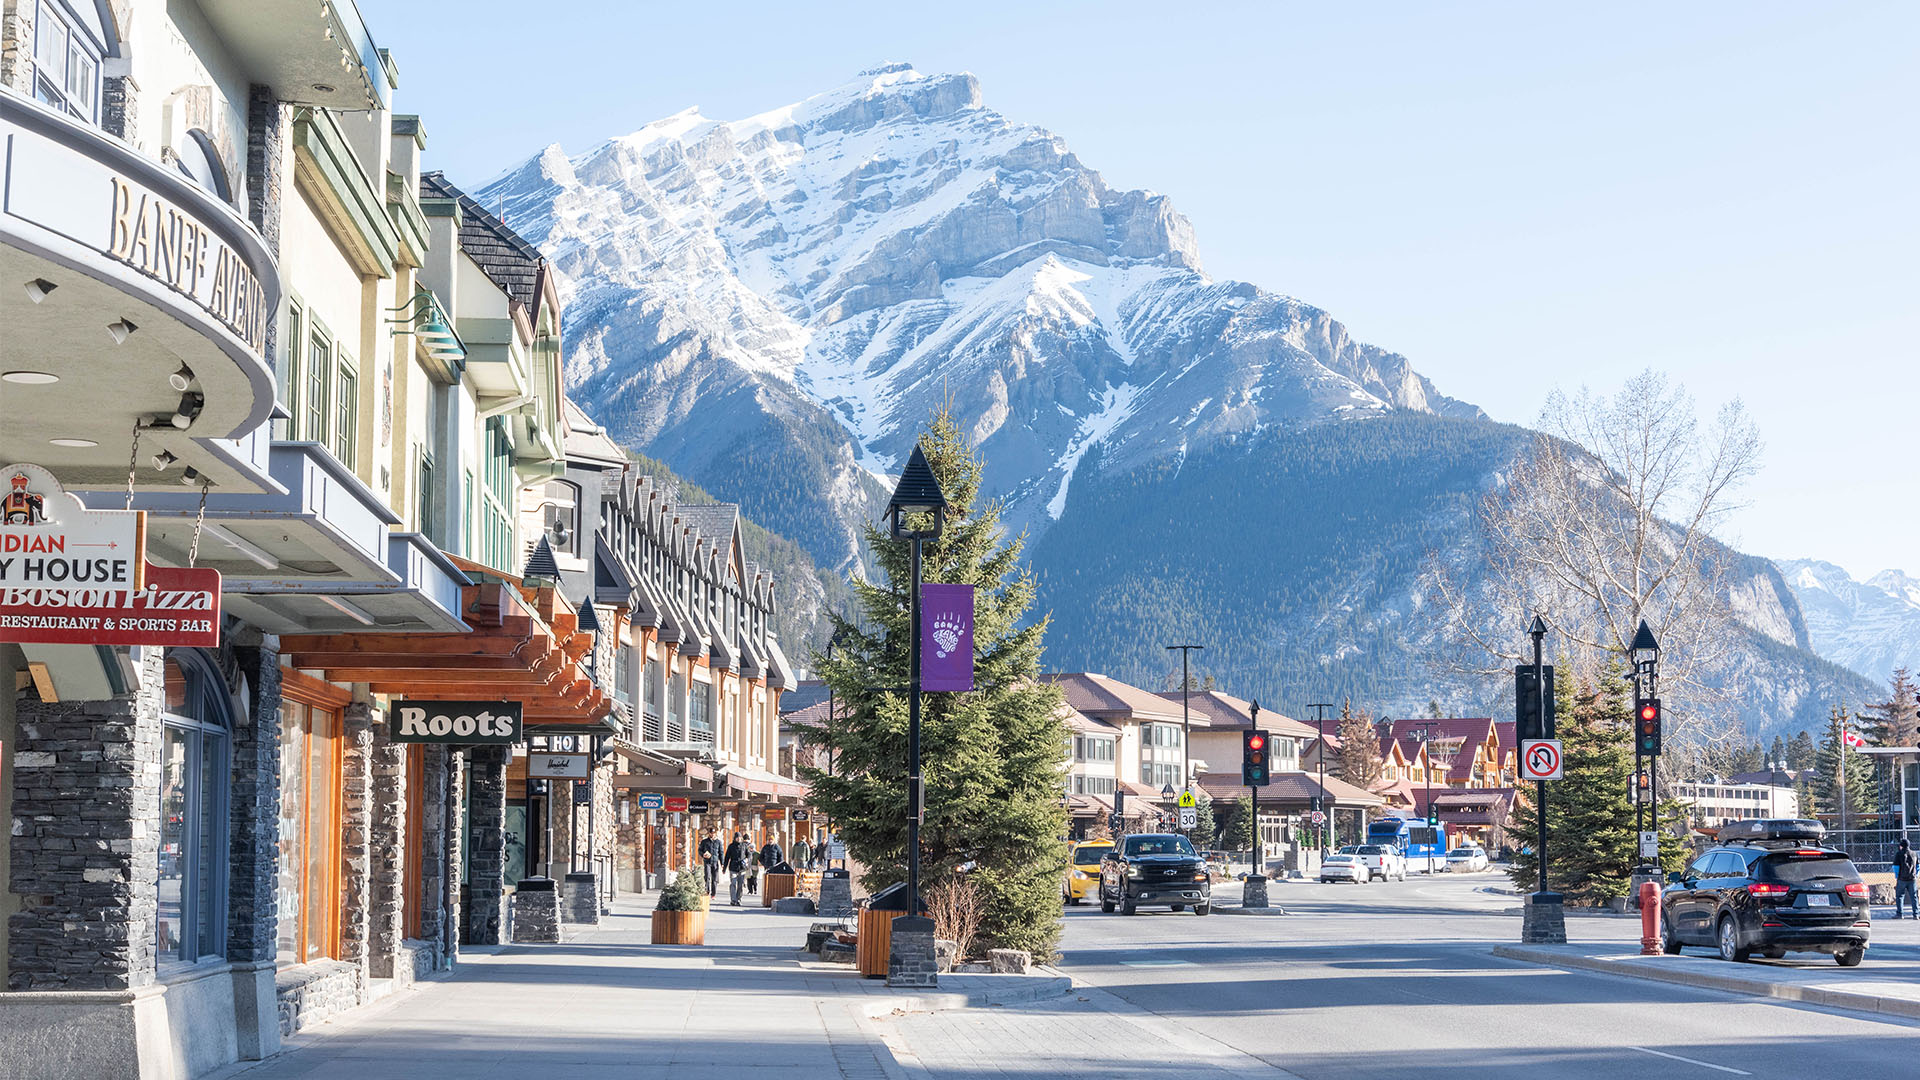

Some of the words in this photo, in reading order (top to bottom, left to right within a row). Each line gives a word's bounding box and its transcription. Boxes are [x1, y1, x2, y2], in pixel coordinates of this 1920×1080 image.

[108, 177, 208, 299] BANFF
[24, 558, 127, 582] HOUSE
[123, 583, 213, 611] Pizza
[1, 615, 100, 630] RESTAURANT
[103, 618, 115, 630] &
[119, 618, 176, 631] SPORTS
[180, 620, 211, 633] BAR
[399, 707, 514, 737] Roots
[1182, 815, 1195, 825] 30
